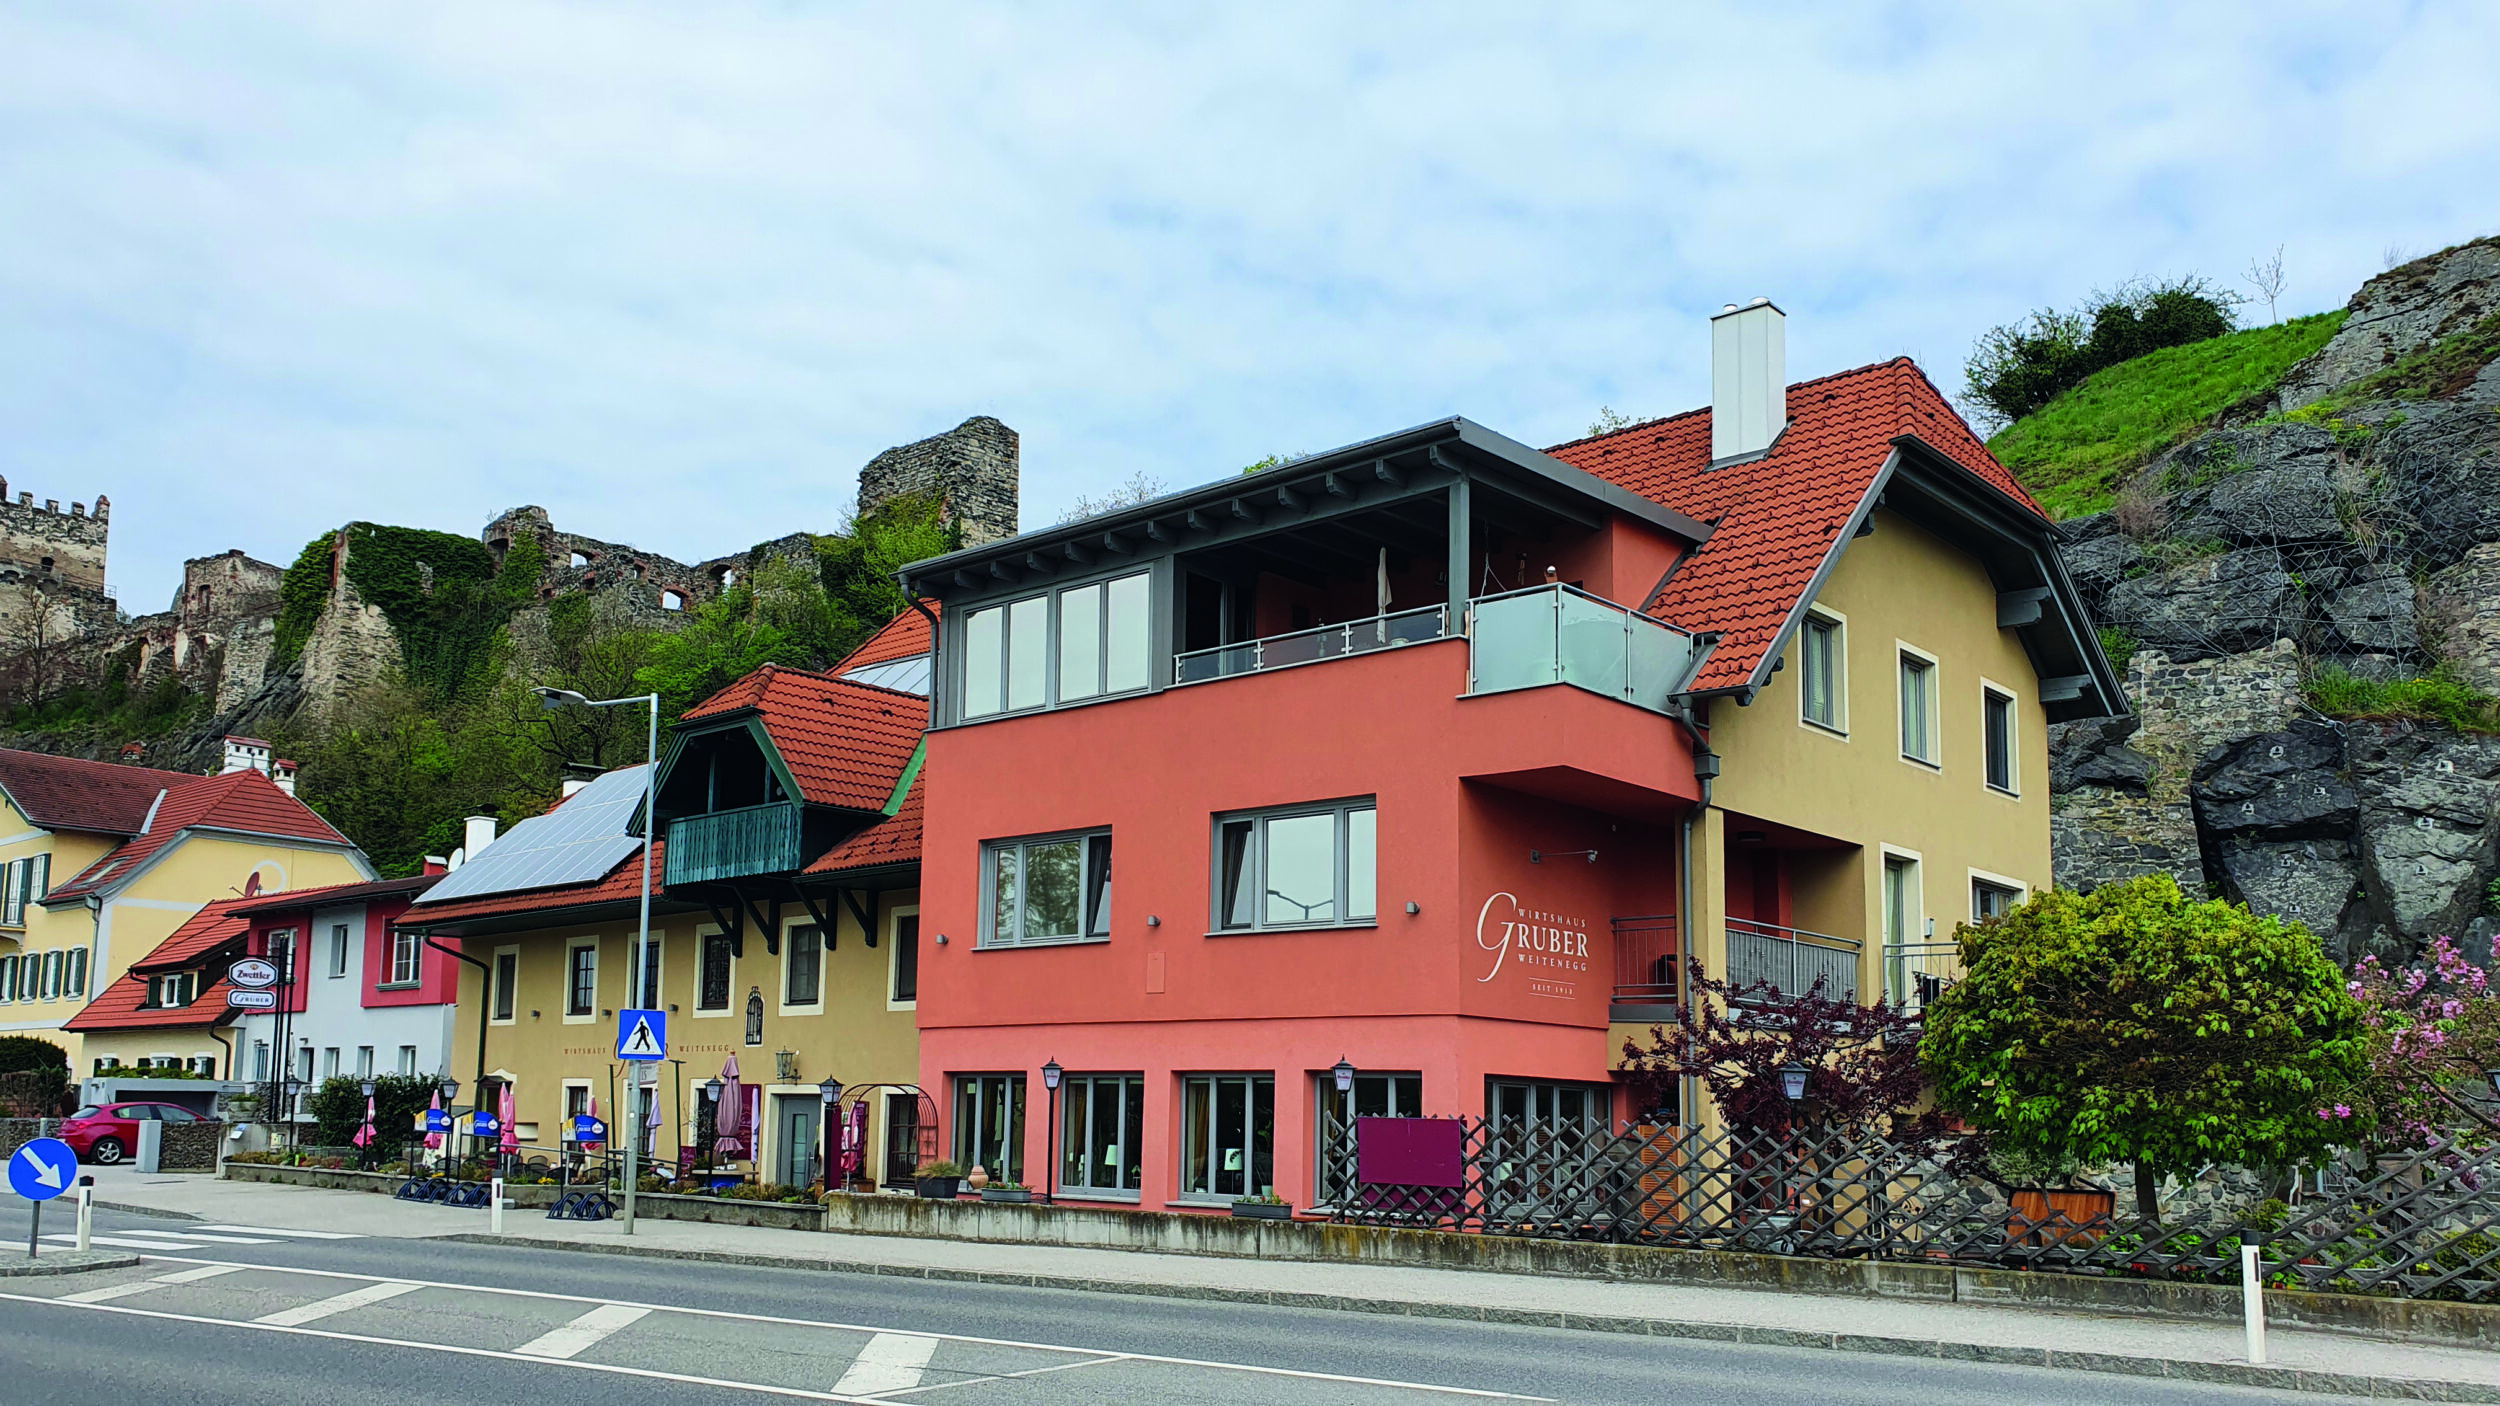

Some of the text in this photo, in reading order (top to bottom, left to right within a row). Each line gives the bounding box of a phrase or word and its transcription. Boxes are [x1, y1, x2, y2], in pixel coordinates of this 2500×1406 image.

[1518, 908, 1587, 928] WIRTSHAUS
[1476, 891, 1589, 982] GRUBER
[1518, 953, 1587, 971] WEITENEGG
[237, 969, 271, 980] Zwettler
[1532, 983, 1551, 992] SEIT
[679, 1044, 729, 1053] WEITENEGG
